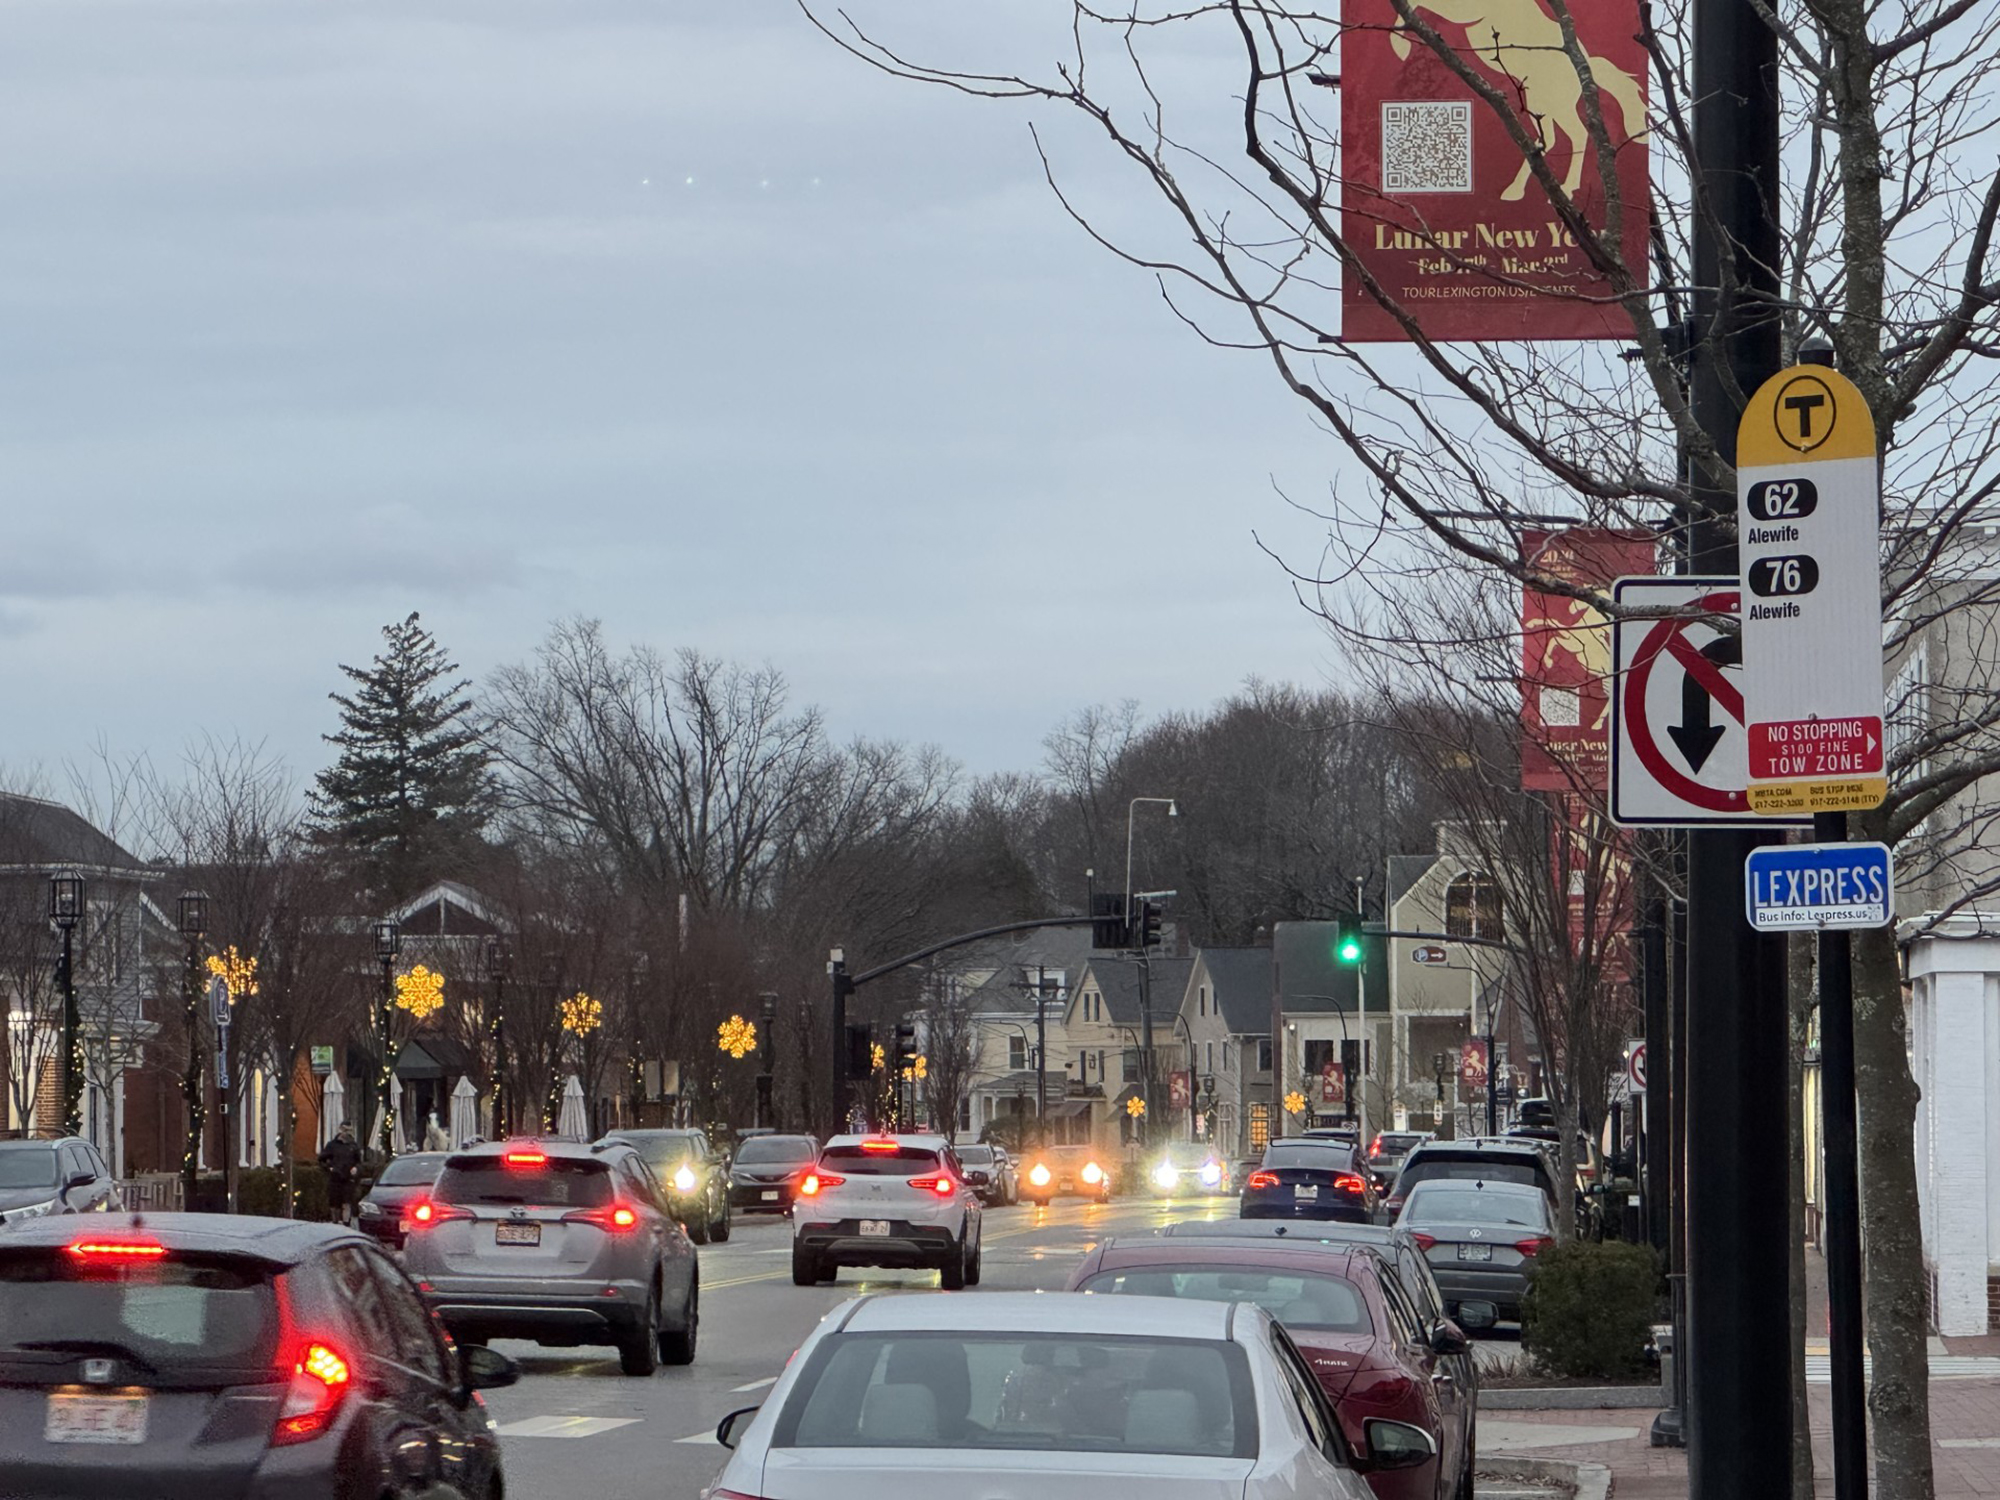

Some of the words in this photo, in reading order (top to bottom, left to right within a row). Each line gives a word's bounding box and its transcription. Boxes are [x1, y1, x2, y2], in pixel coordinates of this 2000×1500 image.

[1375, 225, 1468, 249] Lunar
[1475, 223, 1539, 248] New
[1546, 222, 1606, 247] Ye
[1402, 285, 1577, 298] TOURLEXINGTON.US/ENTS
[1785, 394, 1824, 438] T
[1764, 482, 1800, 517] 62
[1748, 525, 1799, 545] Alewife
[1766, 559, 1801, 593] 76
[1749, 601, 1801, 621] Alewife
[1768, 726, 1788, 742] NO
[1793, 721, 1863, 741] STOPPING
[1819, 741, 1850, 753] FINE
[1768, 756, 1806, 774] TOW
[1816, 753, 1864, 772] ZONE
[1754, 866, 1883, 907] LEXPRESS
[1759, 911, 1779, 922] Bus
[1807, 909, 1868, 921] Lexpress.us
